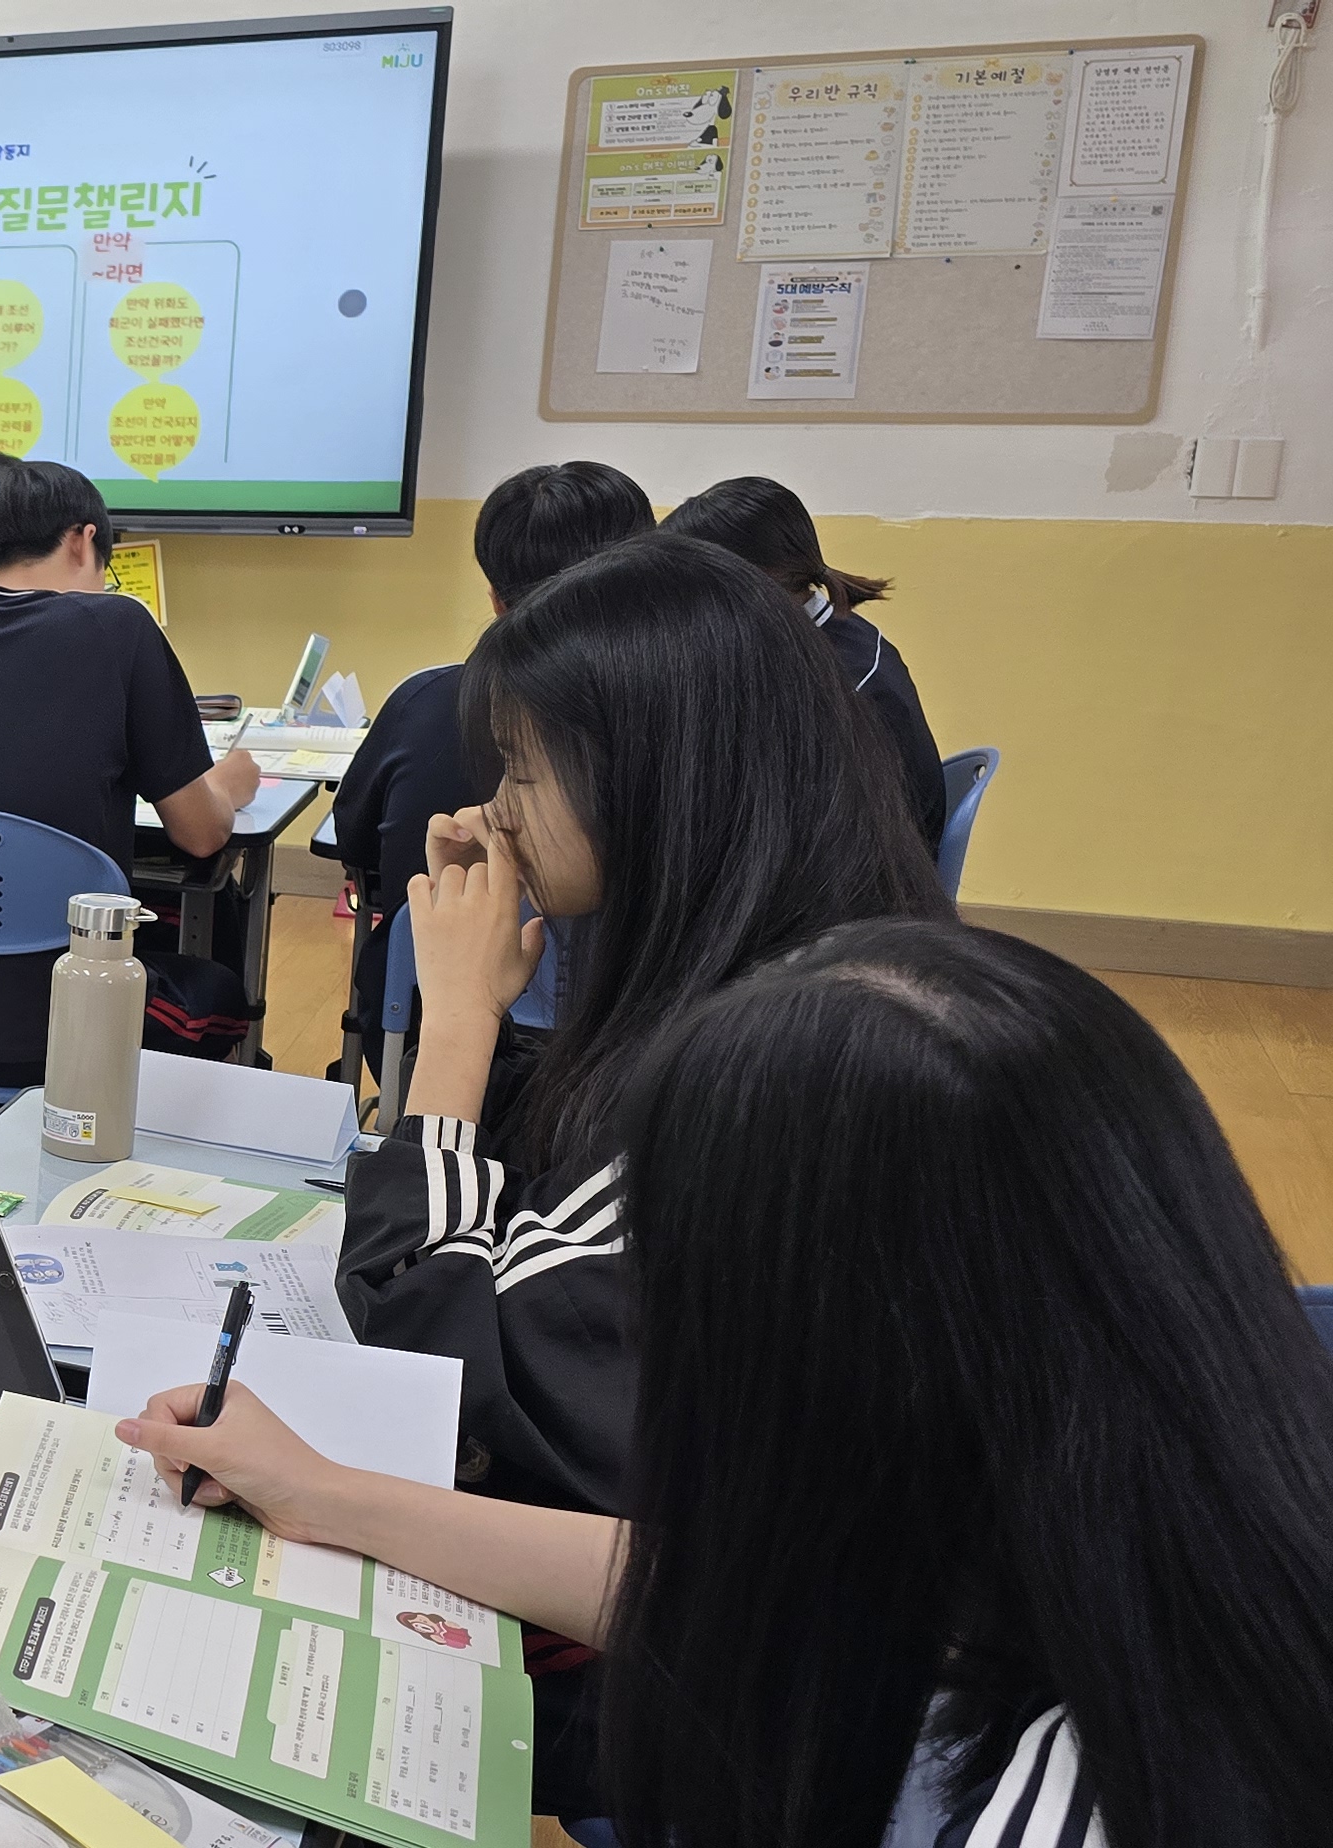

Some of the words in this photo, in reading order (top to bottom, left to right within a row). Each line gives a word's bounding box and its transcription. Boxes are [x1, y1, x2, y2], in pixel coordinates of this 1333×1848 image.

[382, 53, 423, 68] MIJU
[956, 68, 1025, 86] 기본예절
[789, 85, 841, 102] 우리반
[847, 83, 878, 98] 규칙
[93, 232, 132, 253] 만약
[92, 263, 143, 284] ~라면
[777, 283, 797, 295] 5대
[799, 282, 851, 294] 예방수칙
[7, 304, 29, 315] 조선
[126, 297, 149, 309] 만약
[154, 297, 189, 309] 위화도
[2, 322, 35, 335] 이루어
[109, 317, 143, 329] 회군이
[147, 316, 204, 328] 실패했다면
[124, 335, 183, 347] 조선건국이
[143, 398, 166, 410] 만약
[114, 416, 147, 428] 조선이
[152, 415, 197, 428] 건국되지
[160, 434, 195, 447] 어떻게
